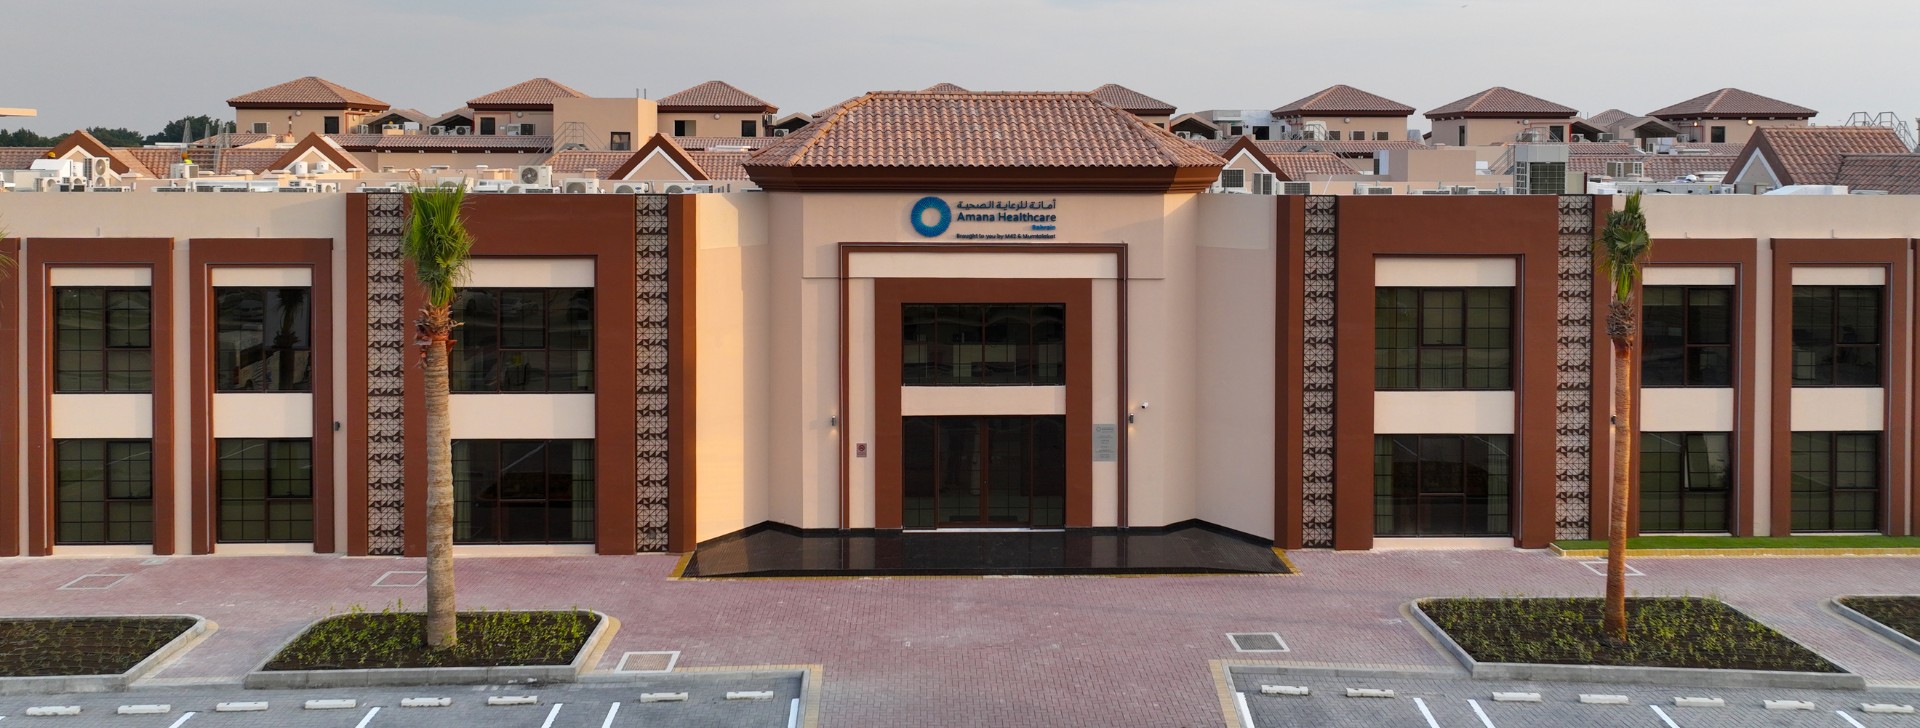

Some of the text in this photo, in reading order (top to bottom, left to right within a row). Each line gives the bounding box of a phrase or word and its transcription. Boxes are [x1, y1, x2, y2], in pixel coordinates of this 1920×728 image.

[956, 199, 1056, 211] أمانة للرعاية الصحية
[957, 212, 1057, 222] Amana Healthcare
